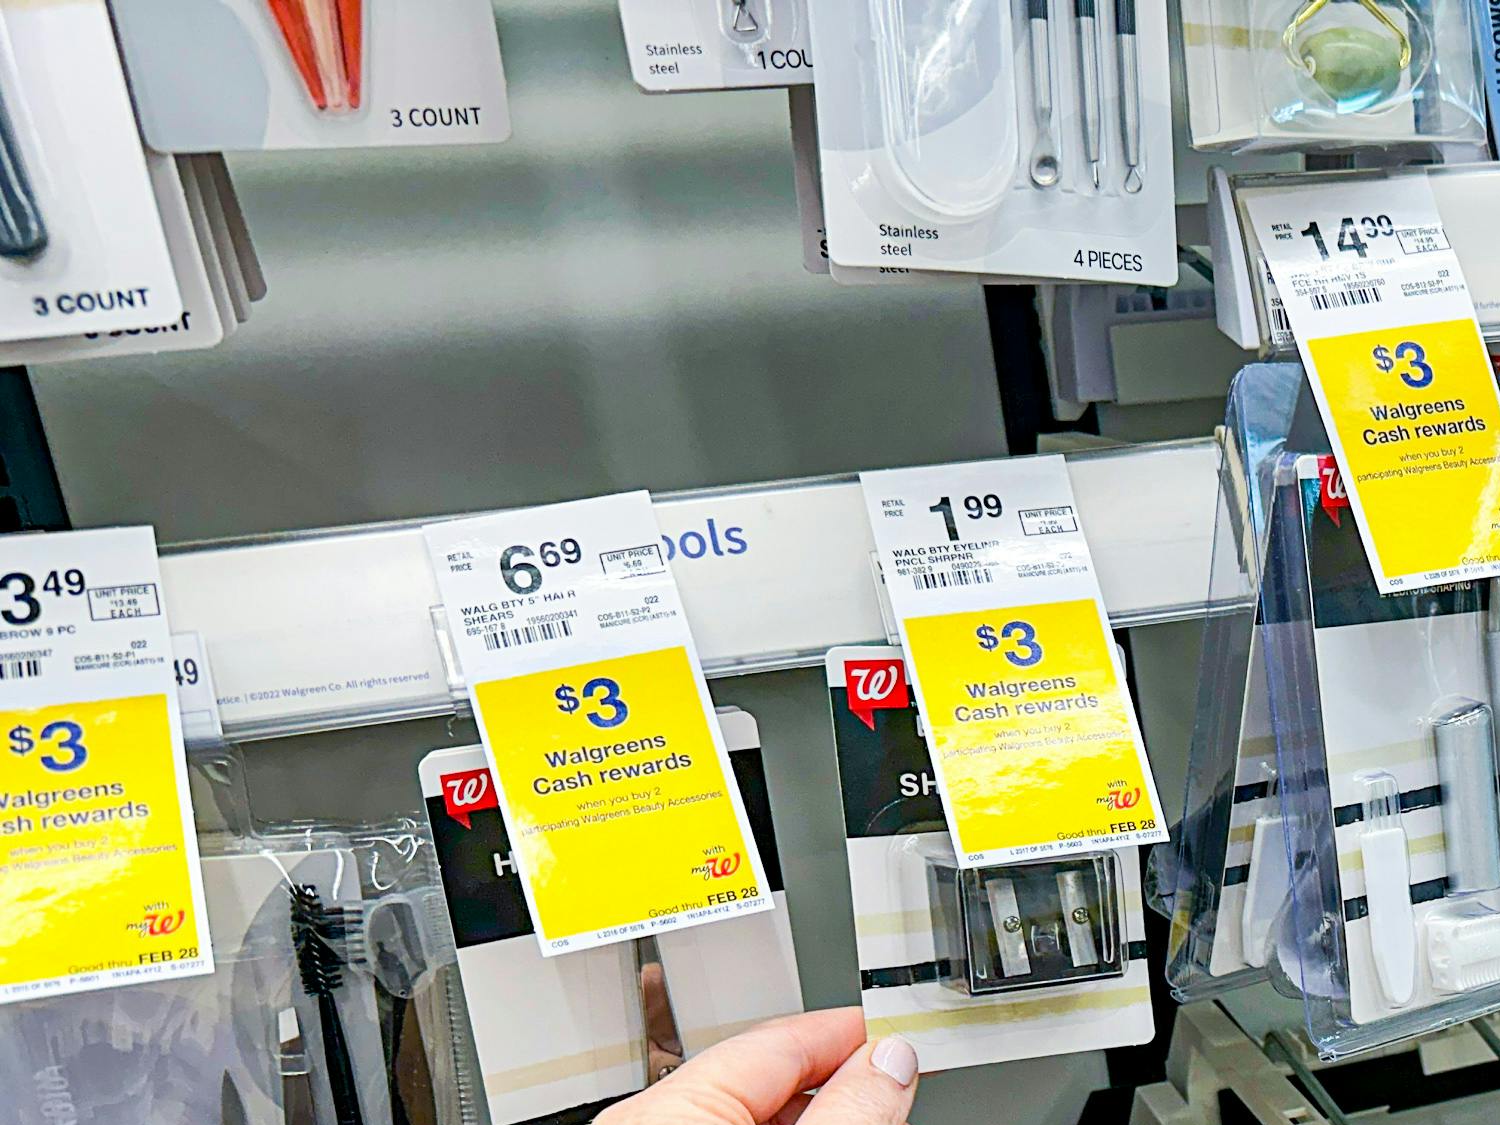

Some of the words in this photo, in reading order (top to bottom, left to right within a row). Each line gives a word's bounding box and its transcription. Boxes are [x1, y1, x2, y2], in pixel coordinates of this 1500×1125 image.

[645, 43, 703, 57] Stainless
[649, 62, 680, 75] steel
[391, 109, 404, 128] 3
[409, 106, 482, 128] COUNT
[879, 224, 939, 240] Stainless
[880, 242, 912, 257] steel
[1073, 249, 1084, 268] 4
[1089, 251, 1144, 272] PIECES
[33, 296, 50, 316] 3
[56, 288, 149, 315] COUNT
[1372, 341, 1434, 389] $3
[1370, 397, 1466, 422] Walgreens
[1362, 426, 1411, 447] Cash
[1414, 416, 1487, 440] rewards
[893, 546, 927, 559] WALG
[929, 543, 951, 556] BTY
[895, 555, 925, 567] PNCL
[927, 550, 974, 565] SHRPNR
[460, 602, 498, 617] WALG
[500, 598, 526, 613] BTY
[463, 610, 515, 628] SHEARS
[975, 621, 1044, 668] $3
[965, 673, 1077, 701] Walgreens
[555, 677, 629, 729] $3
[954, 702, 1010, 723] Cash
[1013, 692, 1099, 714] rewards
[8, 720, 88, 772] $3
[544, 734, 667, 770] Walgreens
[532, 772, 594, 797] Cash
[599, 752, 693, 784] rewards
[576, 798, 604, 812] when
[606, 794, 630, 808] you
[631, 789, 651, 804] buy
[42, 800, 150, 833] rewards
[582, 808, 631, 828] Walgreens
[632, 800, 666, 818] Beauty
[1109, 820, 1139, 835] FEB
[1140, 818, 1156, 831] 28
[702, 843, 726, 857] with
[707, 890, 739, 908] FEB
[740, 885, 760, 900] 28
[139, 948, 174, 966] FEB
[178, 945, 199, 960] 28
